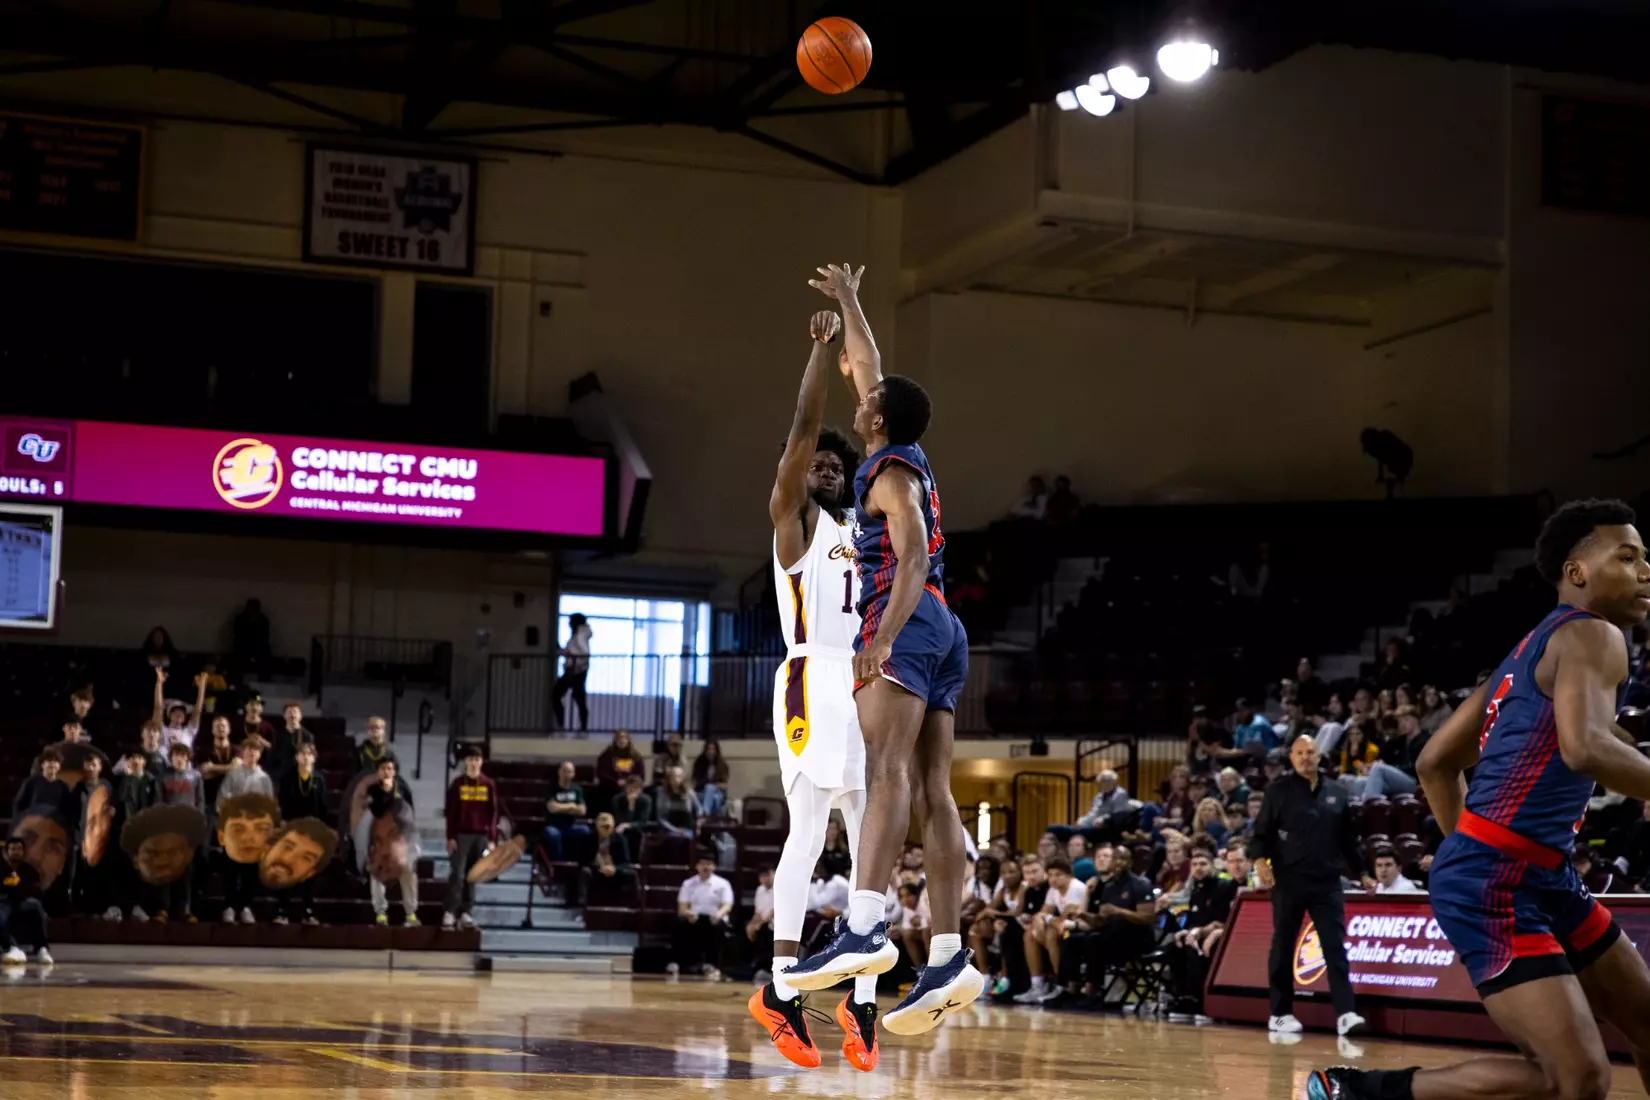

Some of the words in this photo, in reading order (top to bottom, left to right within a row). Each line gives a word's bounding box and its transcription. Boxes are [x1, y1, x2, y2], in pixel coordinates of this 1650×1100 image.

[338, 231, 409, 259] SWEET
[416, 239, 440, 261] 16
[291, 446, 416, 475] CONNECT
[419, 456, 478, 480] CMU
[0, 476, 46, 495] OULS:
[290, 470, 379, 494] Cellular
[382, 476, 476, 501] Services
[289, 497, 340, 511] CENTRAL
[341, 500, 397, 515] MICHIGAN
[397, 504, 463, 519] UNIVERSITY
[842, 570, 853, 614] 1
[1346, 915, 1428, 939] CONNECT
[1392, 943, 1456, 967] Services
